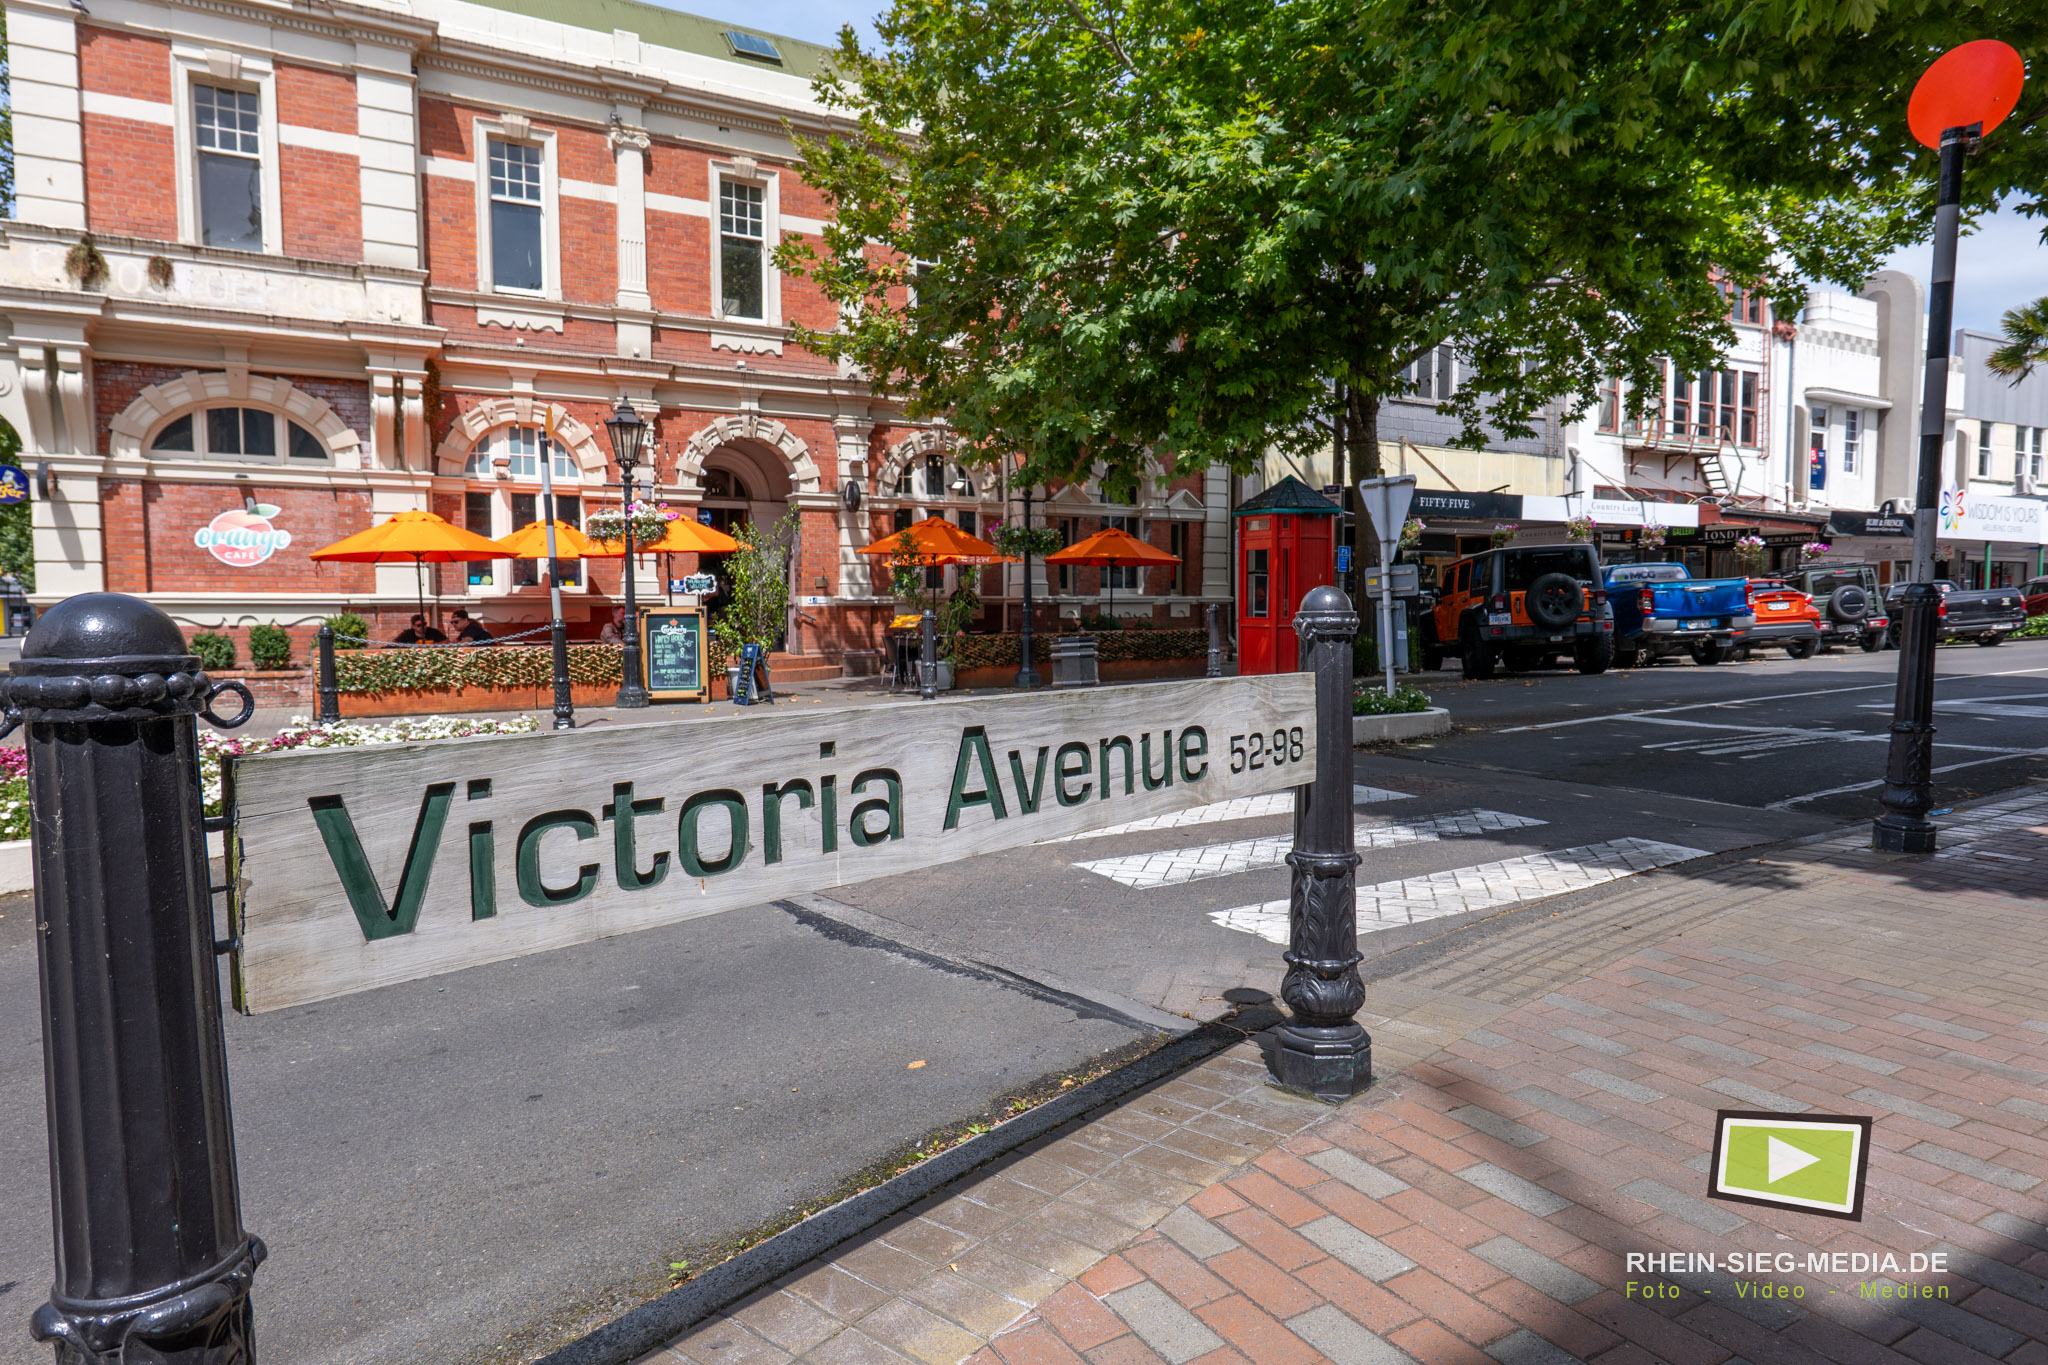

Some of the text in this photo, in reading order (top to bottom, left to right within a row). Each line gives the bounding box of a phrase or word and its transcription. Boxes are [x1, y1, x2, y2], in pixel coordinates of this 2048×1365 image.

[1420, 497, 1470, 509] FIFTY FIVE
[1591, 502, 1639, 512] Country Lane
[1968, 503, 2039, 523] WISDOM IS YOURS
[197, 529, 289, 557] orange
[1630, 571, 1656, 580] MCG
[308, 725, 1304, 942] Victoria Avenue 52-98
